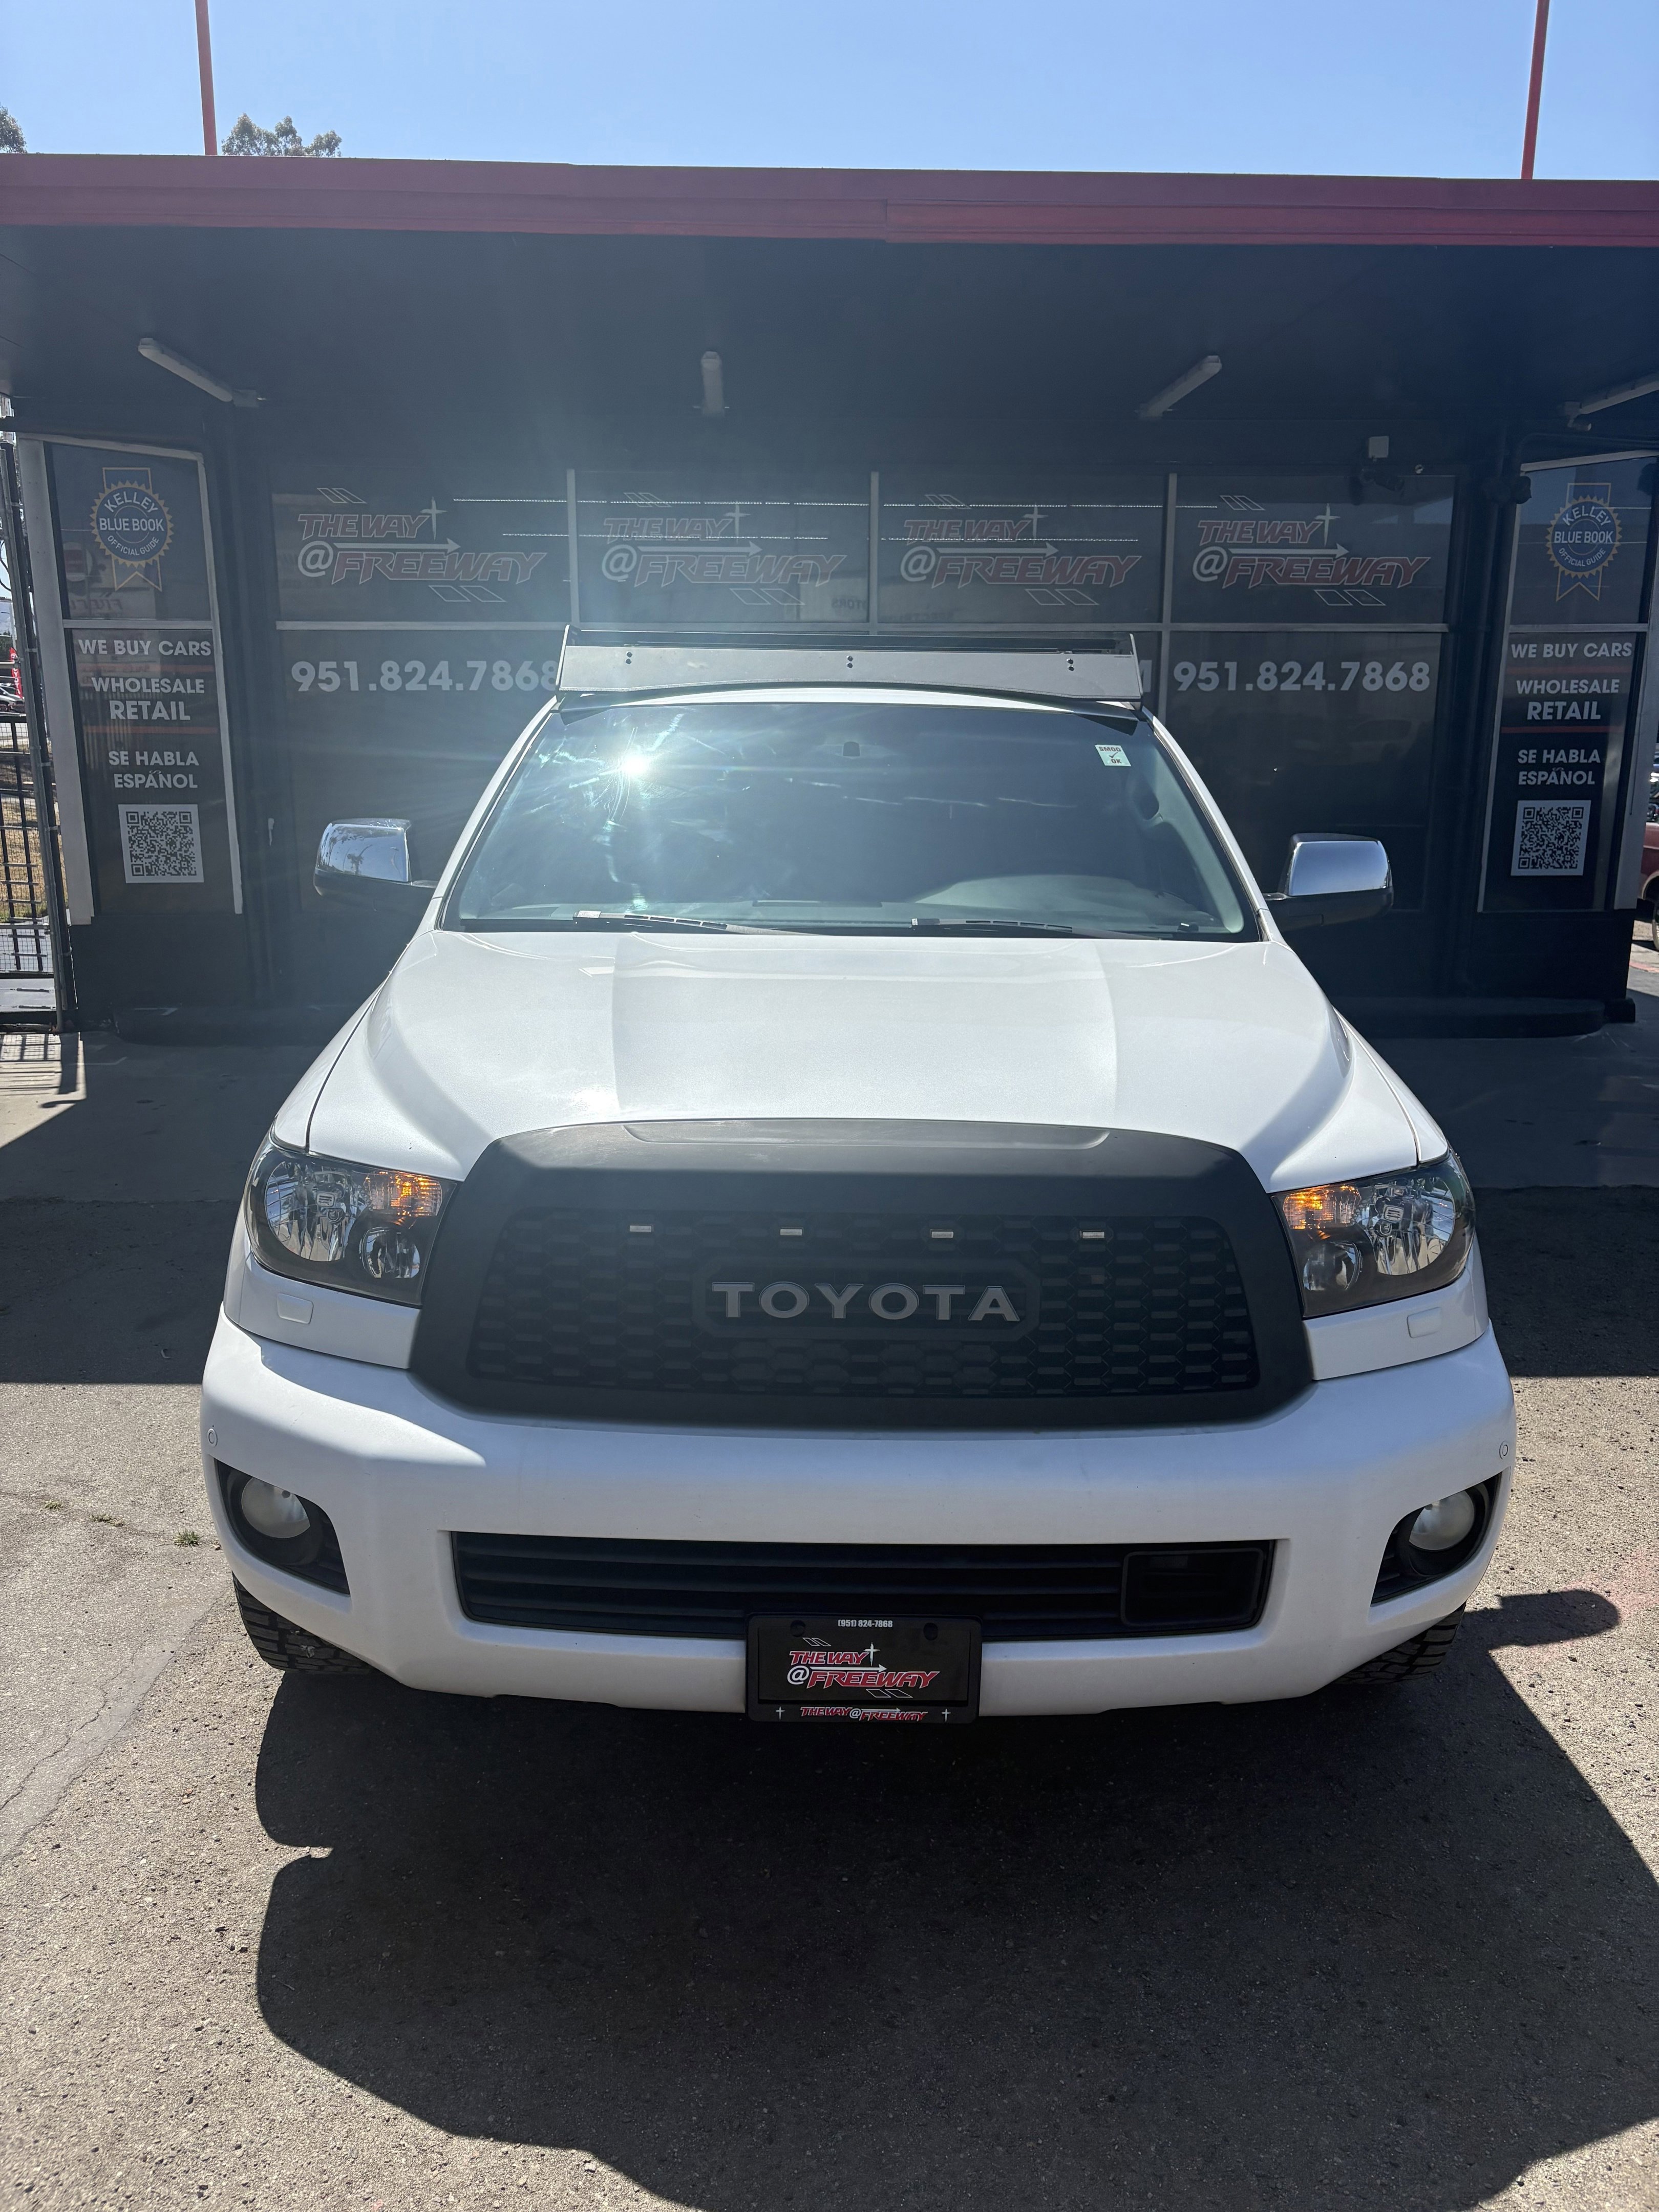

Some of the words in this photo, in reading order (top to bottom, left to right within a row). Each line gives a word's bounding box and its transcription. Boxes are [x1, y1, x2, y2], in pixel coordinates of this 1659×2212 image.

[104, 492, 158, 512] KELLEY
[1563, 505, 1611, 526] KELLEY
[99, 518, 130, 530] BLUE
[132, 518, 164, 531] BOOK
[108, 536, 139, 556] OFFICIAL
[140, 537, 159, 554] GUIDE
[1554, 531, 1582, 543] BLUE
[1584, 531, 1613, 544] BOOK
[1559, 548, 1586, 566] OFFICIAL
[1586, 548, 1606, 565] GUIDE
[78, 640, 108, 655] WE
[114, 640, 151, 655] BUY
[158, 641, 211, 656] CARS
[1511, 644, 1537, 658] WE
[1543, 643, 1578, 657] BUY
[1583, 642, 1632, 657] CARS
[91, 677, 204, 693] WHOLESALE
[291, 661, 558, 692] 951.824.7868
[1174, 662, 1430, 692] 951.824.7868
[1516, 679, 1620, 694] WHOLESALE
[109, 700, 190, 720] RETAIL
[1527, 701, 1601, 720] RETAIL
[109, 751, 129, 765] SE
[136, 751, 199, 766] HABLA
[1518, 750, 1537, 763] SE
[1542, 749, 1601, 763] HABLA
[712, 1281, 1020, 1322] TOYOTA
[838, 1619, 857, 1628] (951)
[858, 1620, 893, 1628] 824-7868
